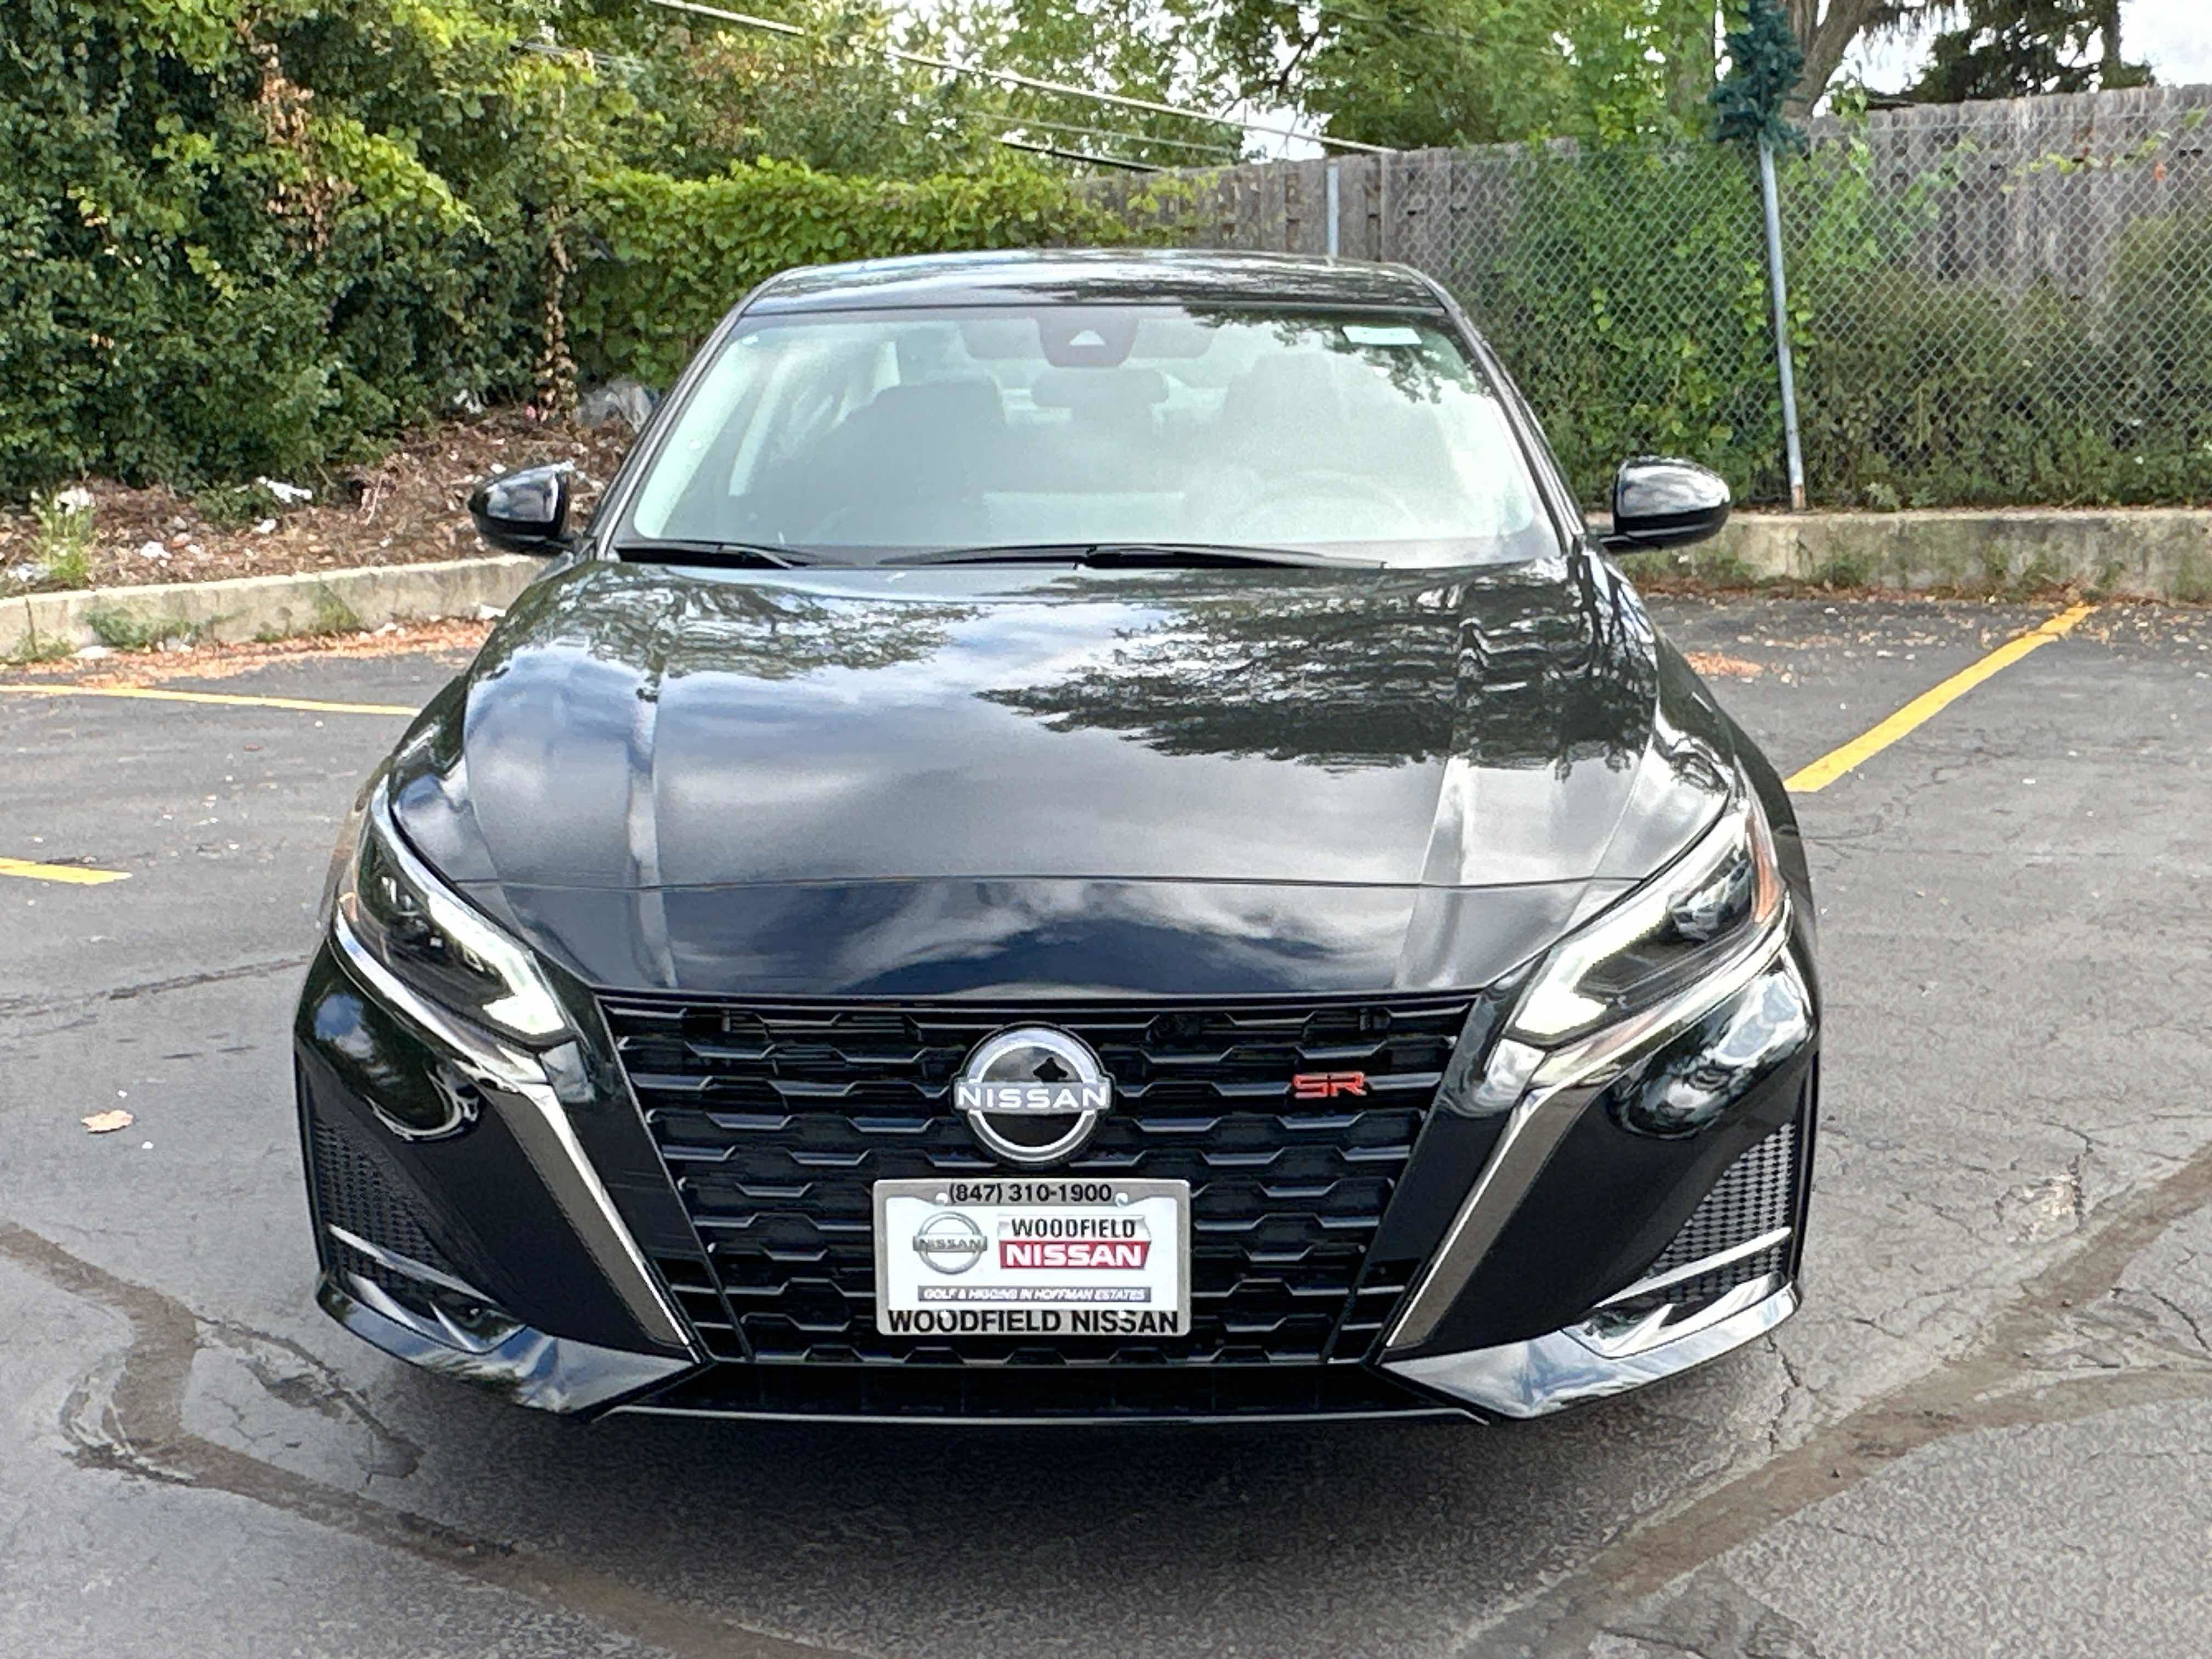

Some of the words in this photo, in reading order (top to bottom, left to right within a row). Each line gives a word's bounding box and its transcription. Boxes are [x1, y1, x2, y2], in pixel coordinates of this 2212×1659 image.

[1293, 1071, 1367, 1098] SR
[958, 1087, 1107, 1108] NISSAN
[949, 1183, 1003, 1203] (847)
[1008, 1184, 1112, 1202] 310-1900
[1011, 1218, 1136, 1239] WOODFIELD
[919, 1239, 981, 1251] NISSAN
[1006, 1244, 1142, 1267] NISSAN
[923, 1289, 957, 1300] GOLF
[1019, 1289, 1033, 1300] IN
[1034, 1289, 1094, 1300] HOFFMAN
[1094, 1289, 1146, 1301] ESTATES
[888, 1310, 1062, 1333] WOODFIELD
[1071, 1310, 1178, 1333] NISSAN
